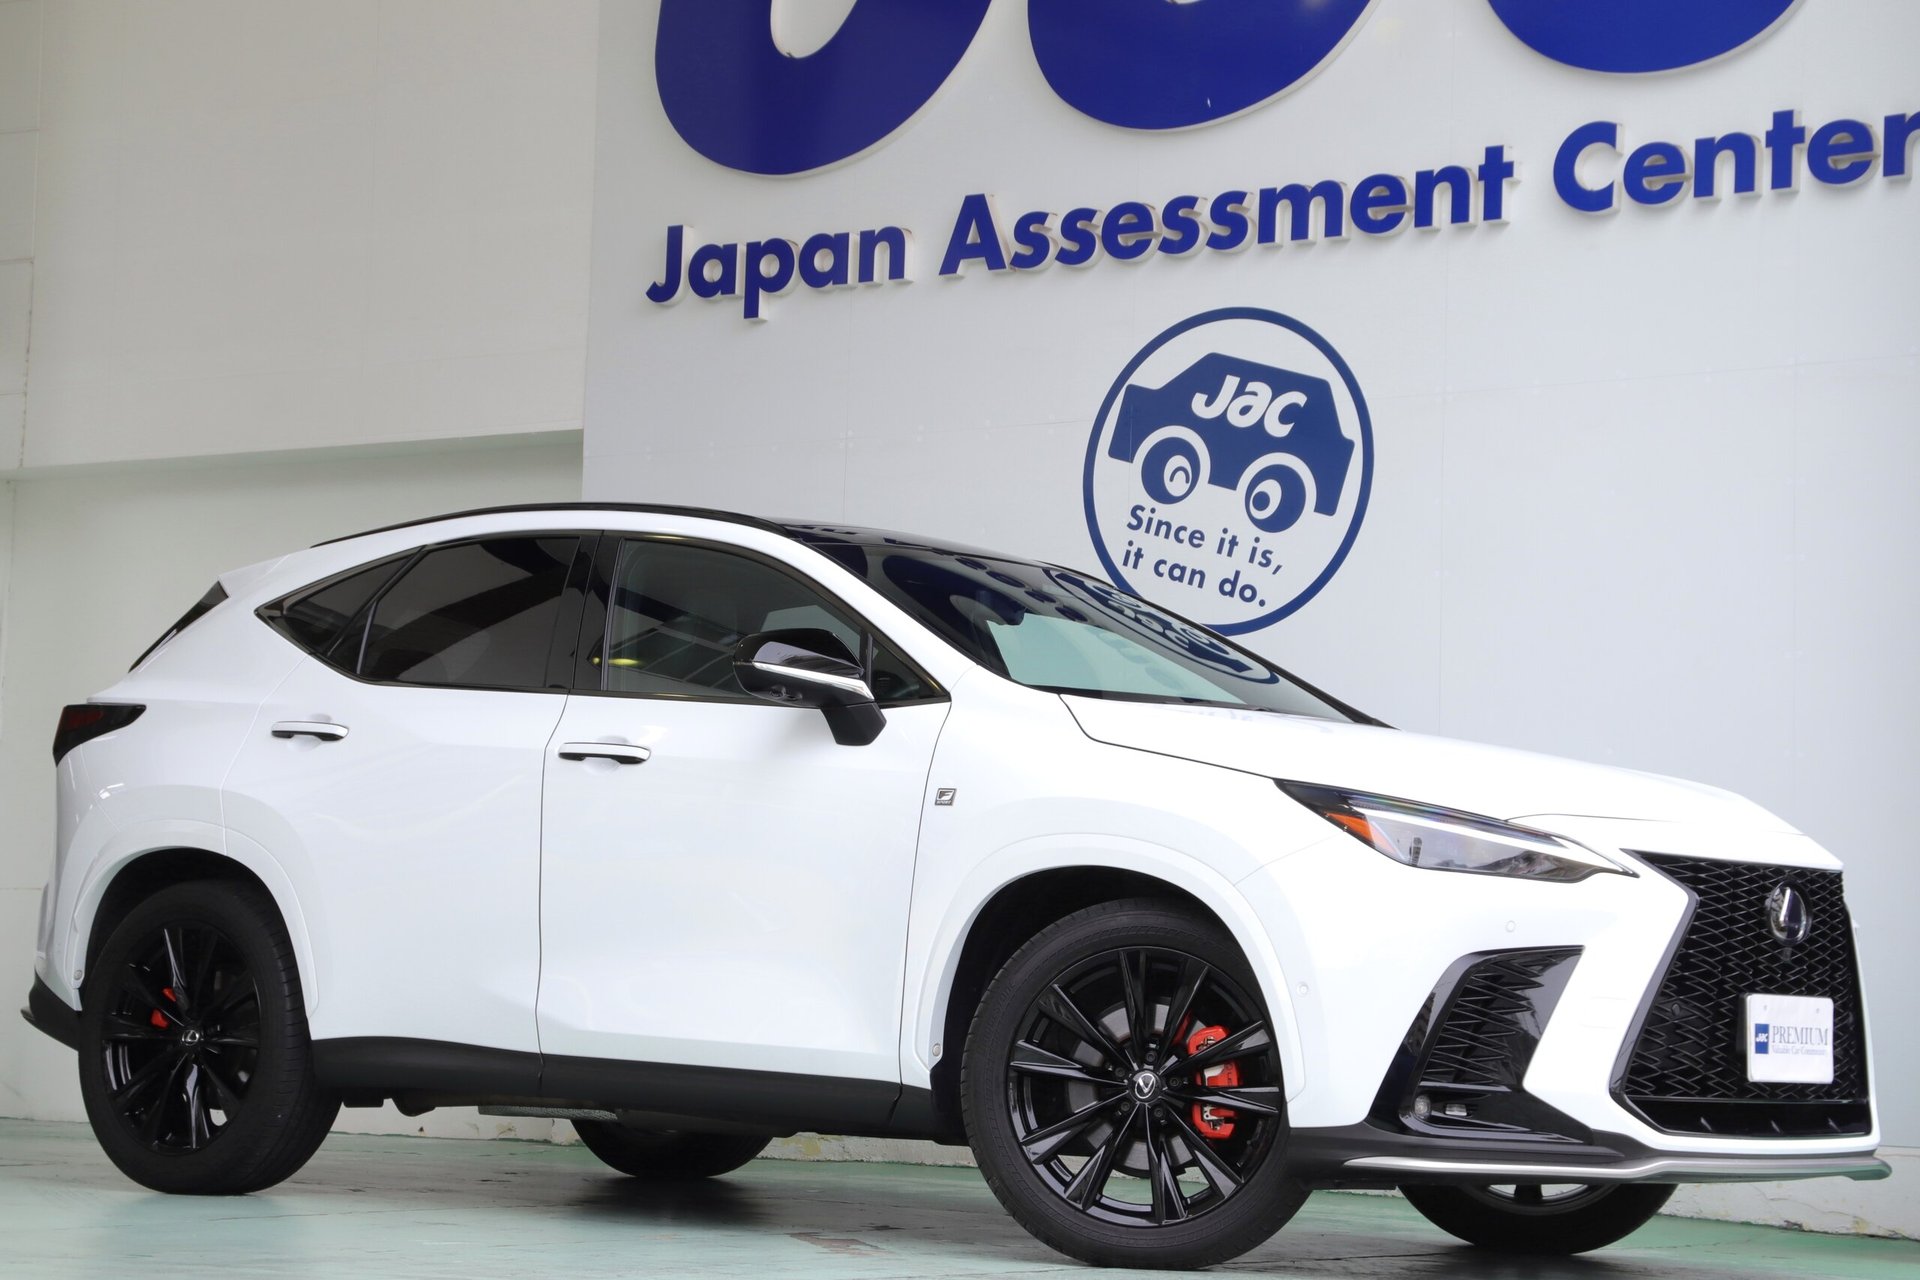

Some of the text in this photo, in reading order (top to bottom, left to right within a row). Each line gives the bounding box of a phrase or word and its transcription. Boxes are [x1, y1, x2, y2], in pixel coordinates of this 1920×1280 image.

[645, 109, 1920, 321] Japan Assessment Center
[1122, 540, 1266, 607] it can do.
[1126, 504, 1283, 576] Since it is,
[1772, 1026, 1828, 1046] PREMIUM
